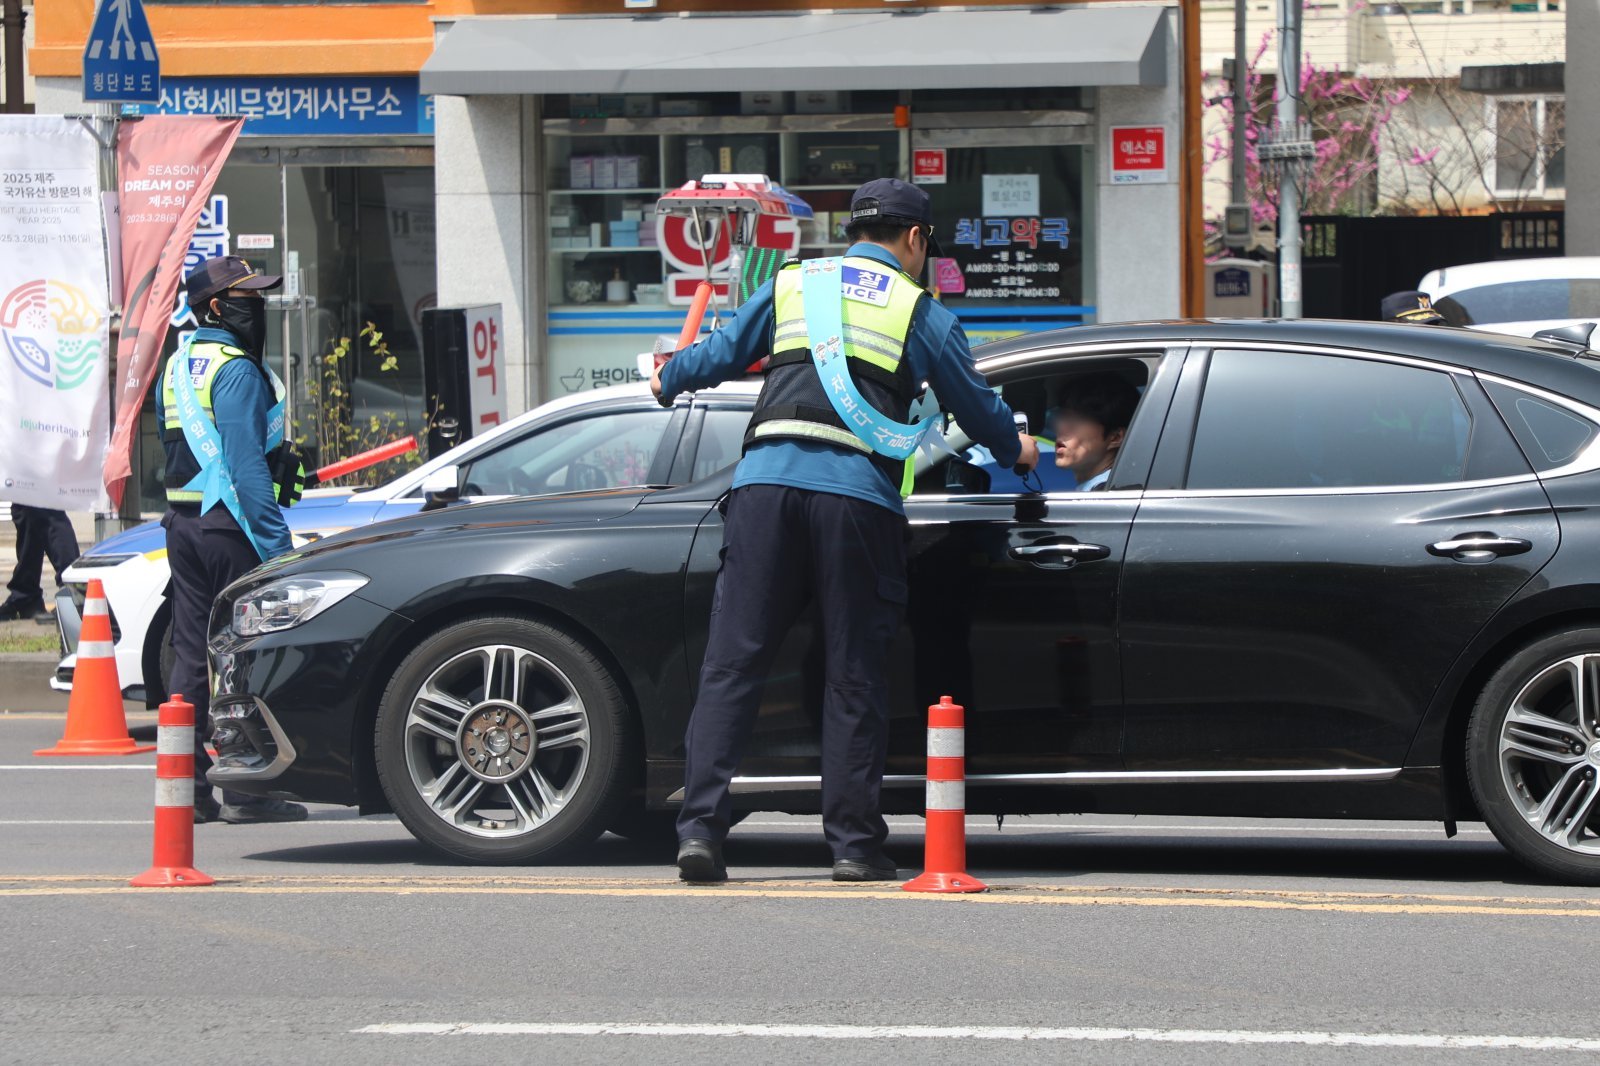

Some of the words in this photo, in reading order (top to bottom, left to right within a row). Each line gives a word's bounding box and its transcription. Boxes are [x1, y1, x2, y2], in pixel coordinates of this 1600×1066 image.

[93, 72, 152, 92] 횡단보도
[147, 165, 199, 176] SEASON
[3, 173, 32, 184] 2025
[34, 173, 56, 184] 제주
[4, 187, 46, 198] 국가유산
[48, 187, 80, 198] 방문의
[82, 187, 93, 198] 해
[124, 180, 172, 192] DREAM
[175, 180, 195, 191] OF
[148, 195, 186, 208] 제주의
[0, 206, 15, 215] ISIT
[18, 206, 38, 215] JEJU
[40, 206, 81, 215] HERITAGE
[16, 217, 40, 225] YEAR
[42, 217, 61, 225] 2025
[955, 218, 1070, 249] 최고약국
[858, 271, 883, 289] 찰
[841, 286, 877, 300] ICE
[191, 359, 206, 375] 찰
[20, 418, 91, 438] jejuheritage.kr
[201, 438, 220, 463] 일
